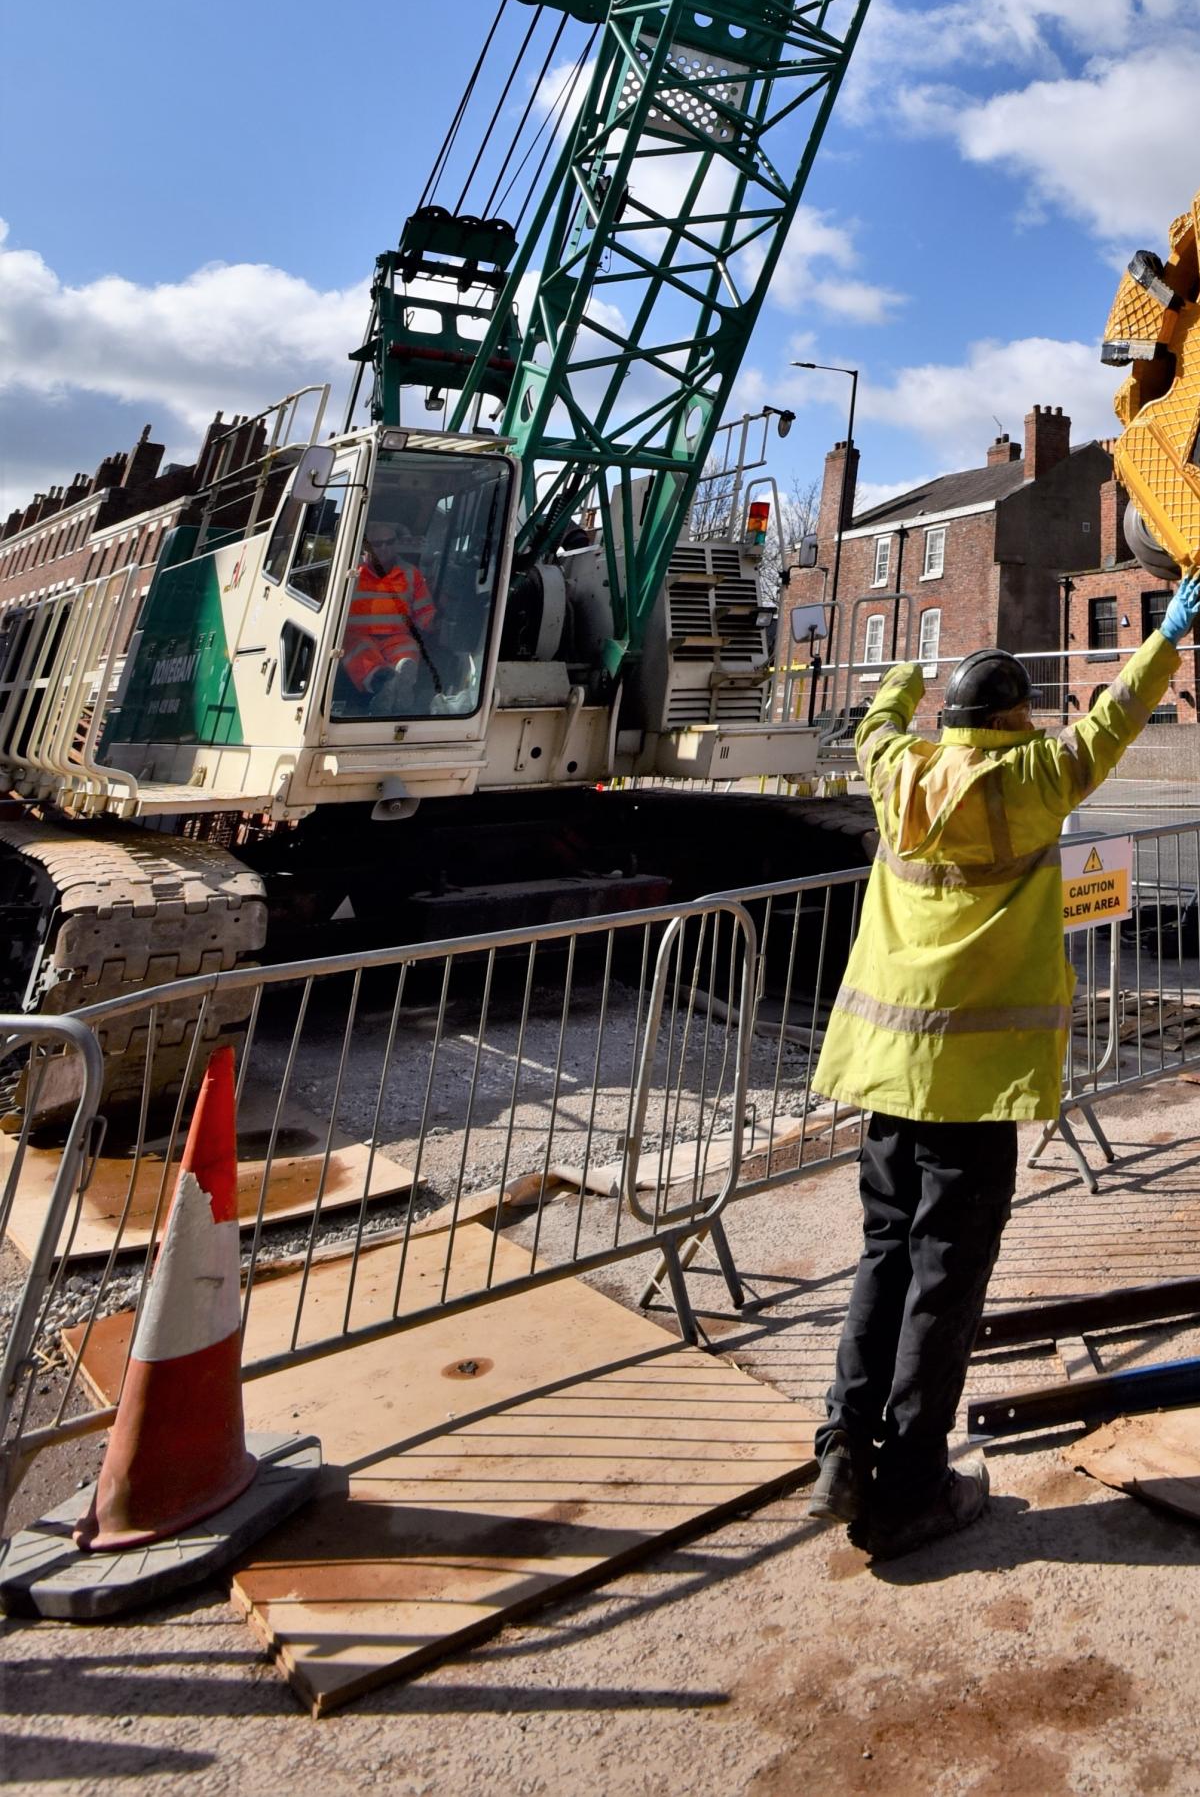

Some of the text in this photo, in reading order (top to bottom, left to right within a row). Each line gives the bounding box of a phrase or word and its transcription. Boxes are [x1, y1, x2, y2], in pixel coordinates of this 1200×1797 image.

[1069, 879, 1114, 898] CAUTION
[1063, 896, 1120, 919] SLEW AREA
